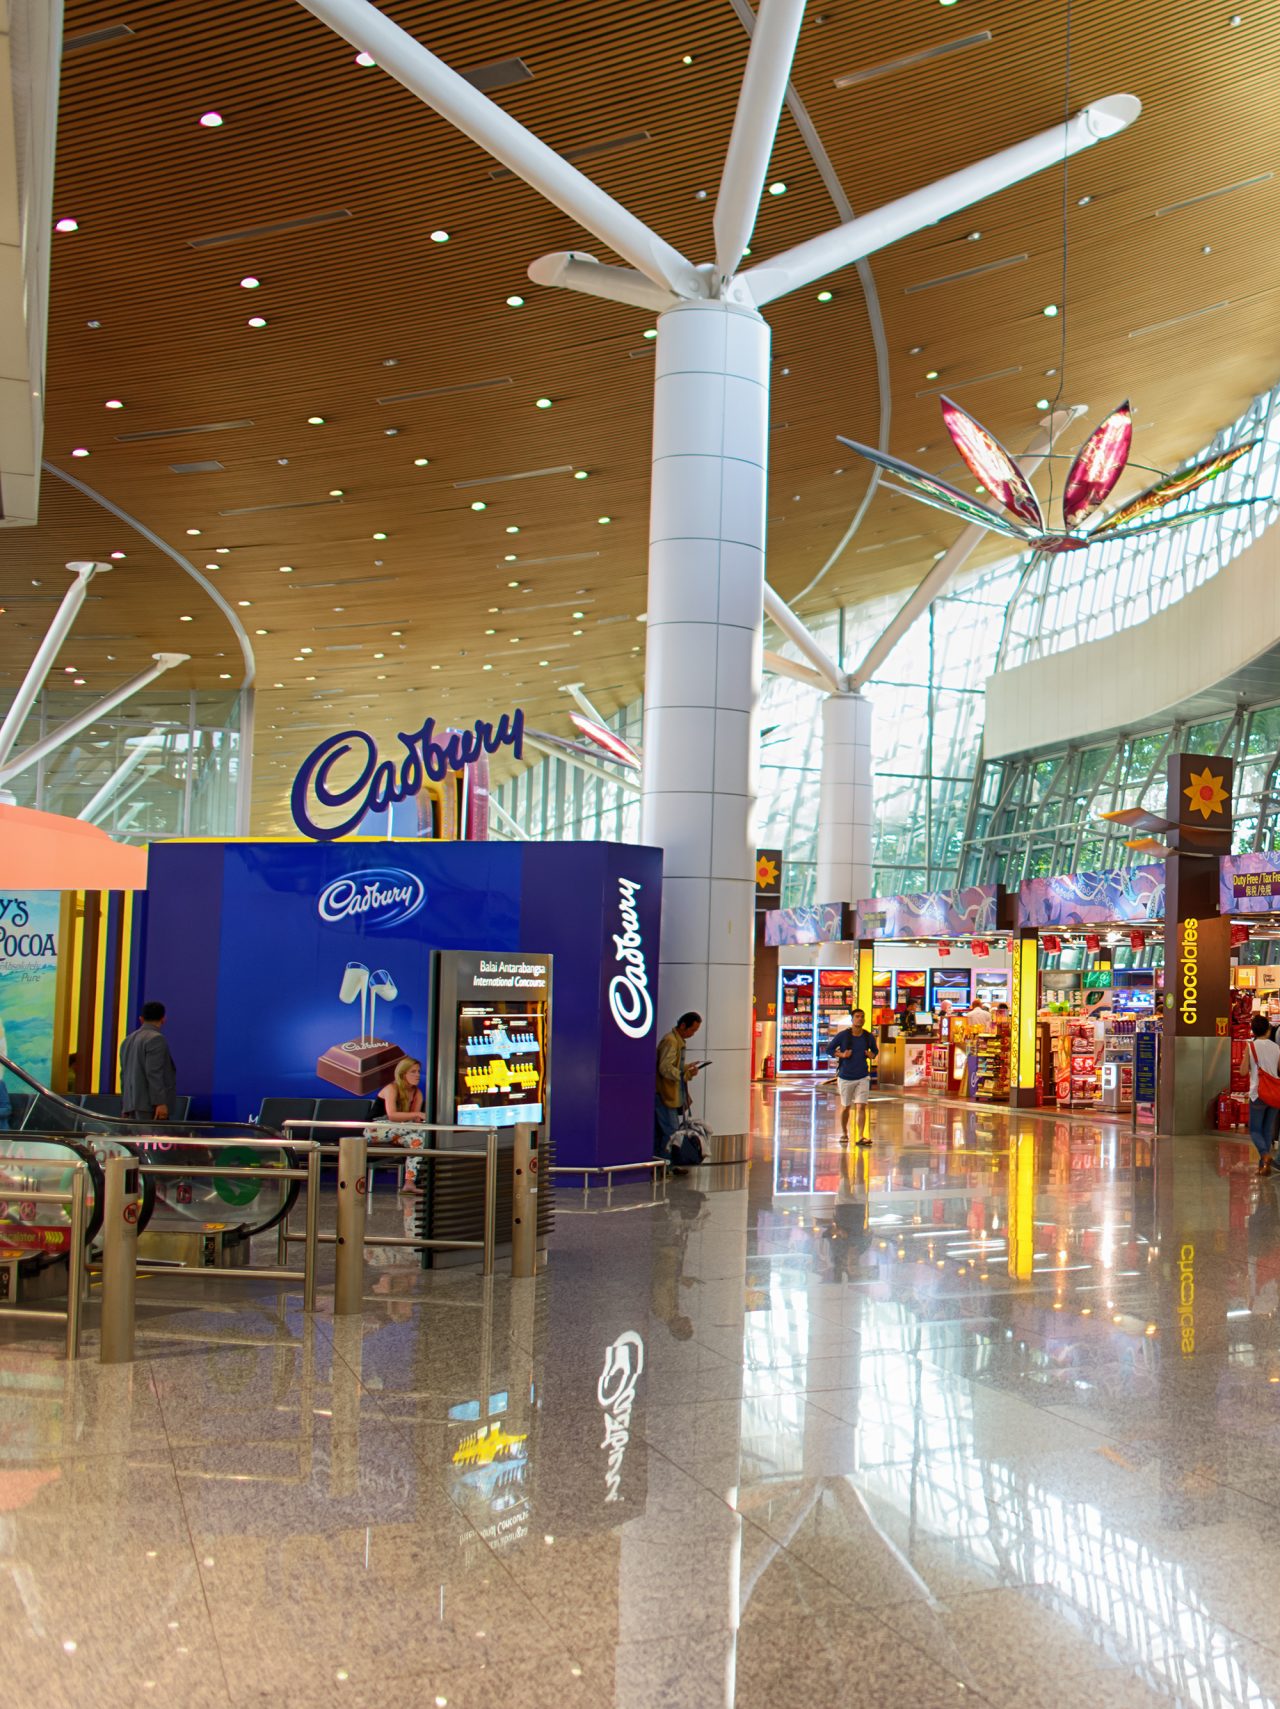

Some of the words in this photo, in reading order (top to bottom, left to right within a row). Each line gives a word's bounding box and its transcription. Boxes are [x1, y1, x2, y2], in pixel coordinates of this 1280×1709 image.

[291, 708, 524, 841] Cadbury
[1246, 874, 1259, 884] Free
[318, 880, 413, 922] Cadbury
[480, 960, 498, 973] Balai
[498, 961, 546, 977] Antarabangsa
[609, 877, 653, 1039] Cadbury
[1180, 917, 1198, 1024] chocolates
[473, 975, 514, 987] International
[514, 976, 546, 987] Concourse
[341, 1041, 389, 1052] Cadbury
